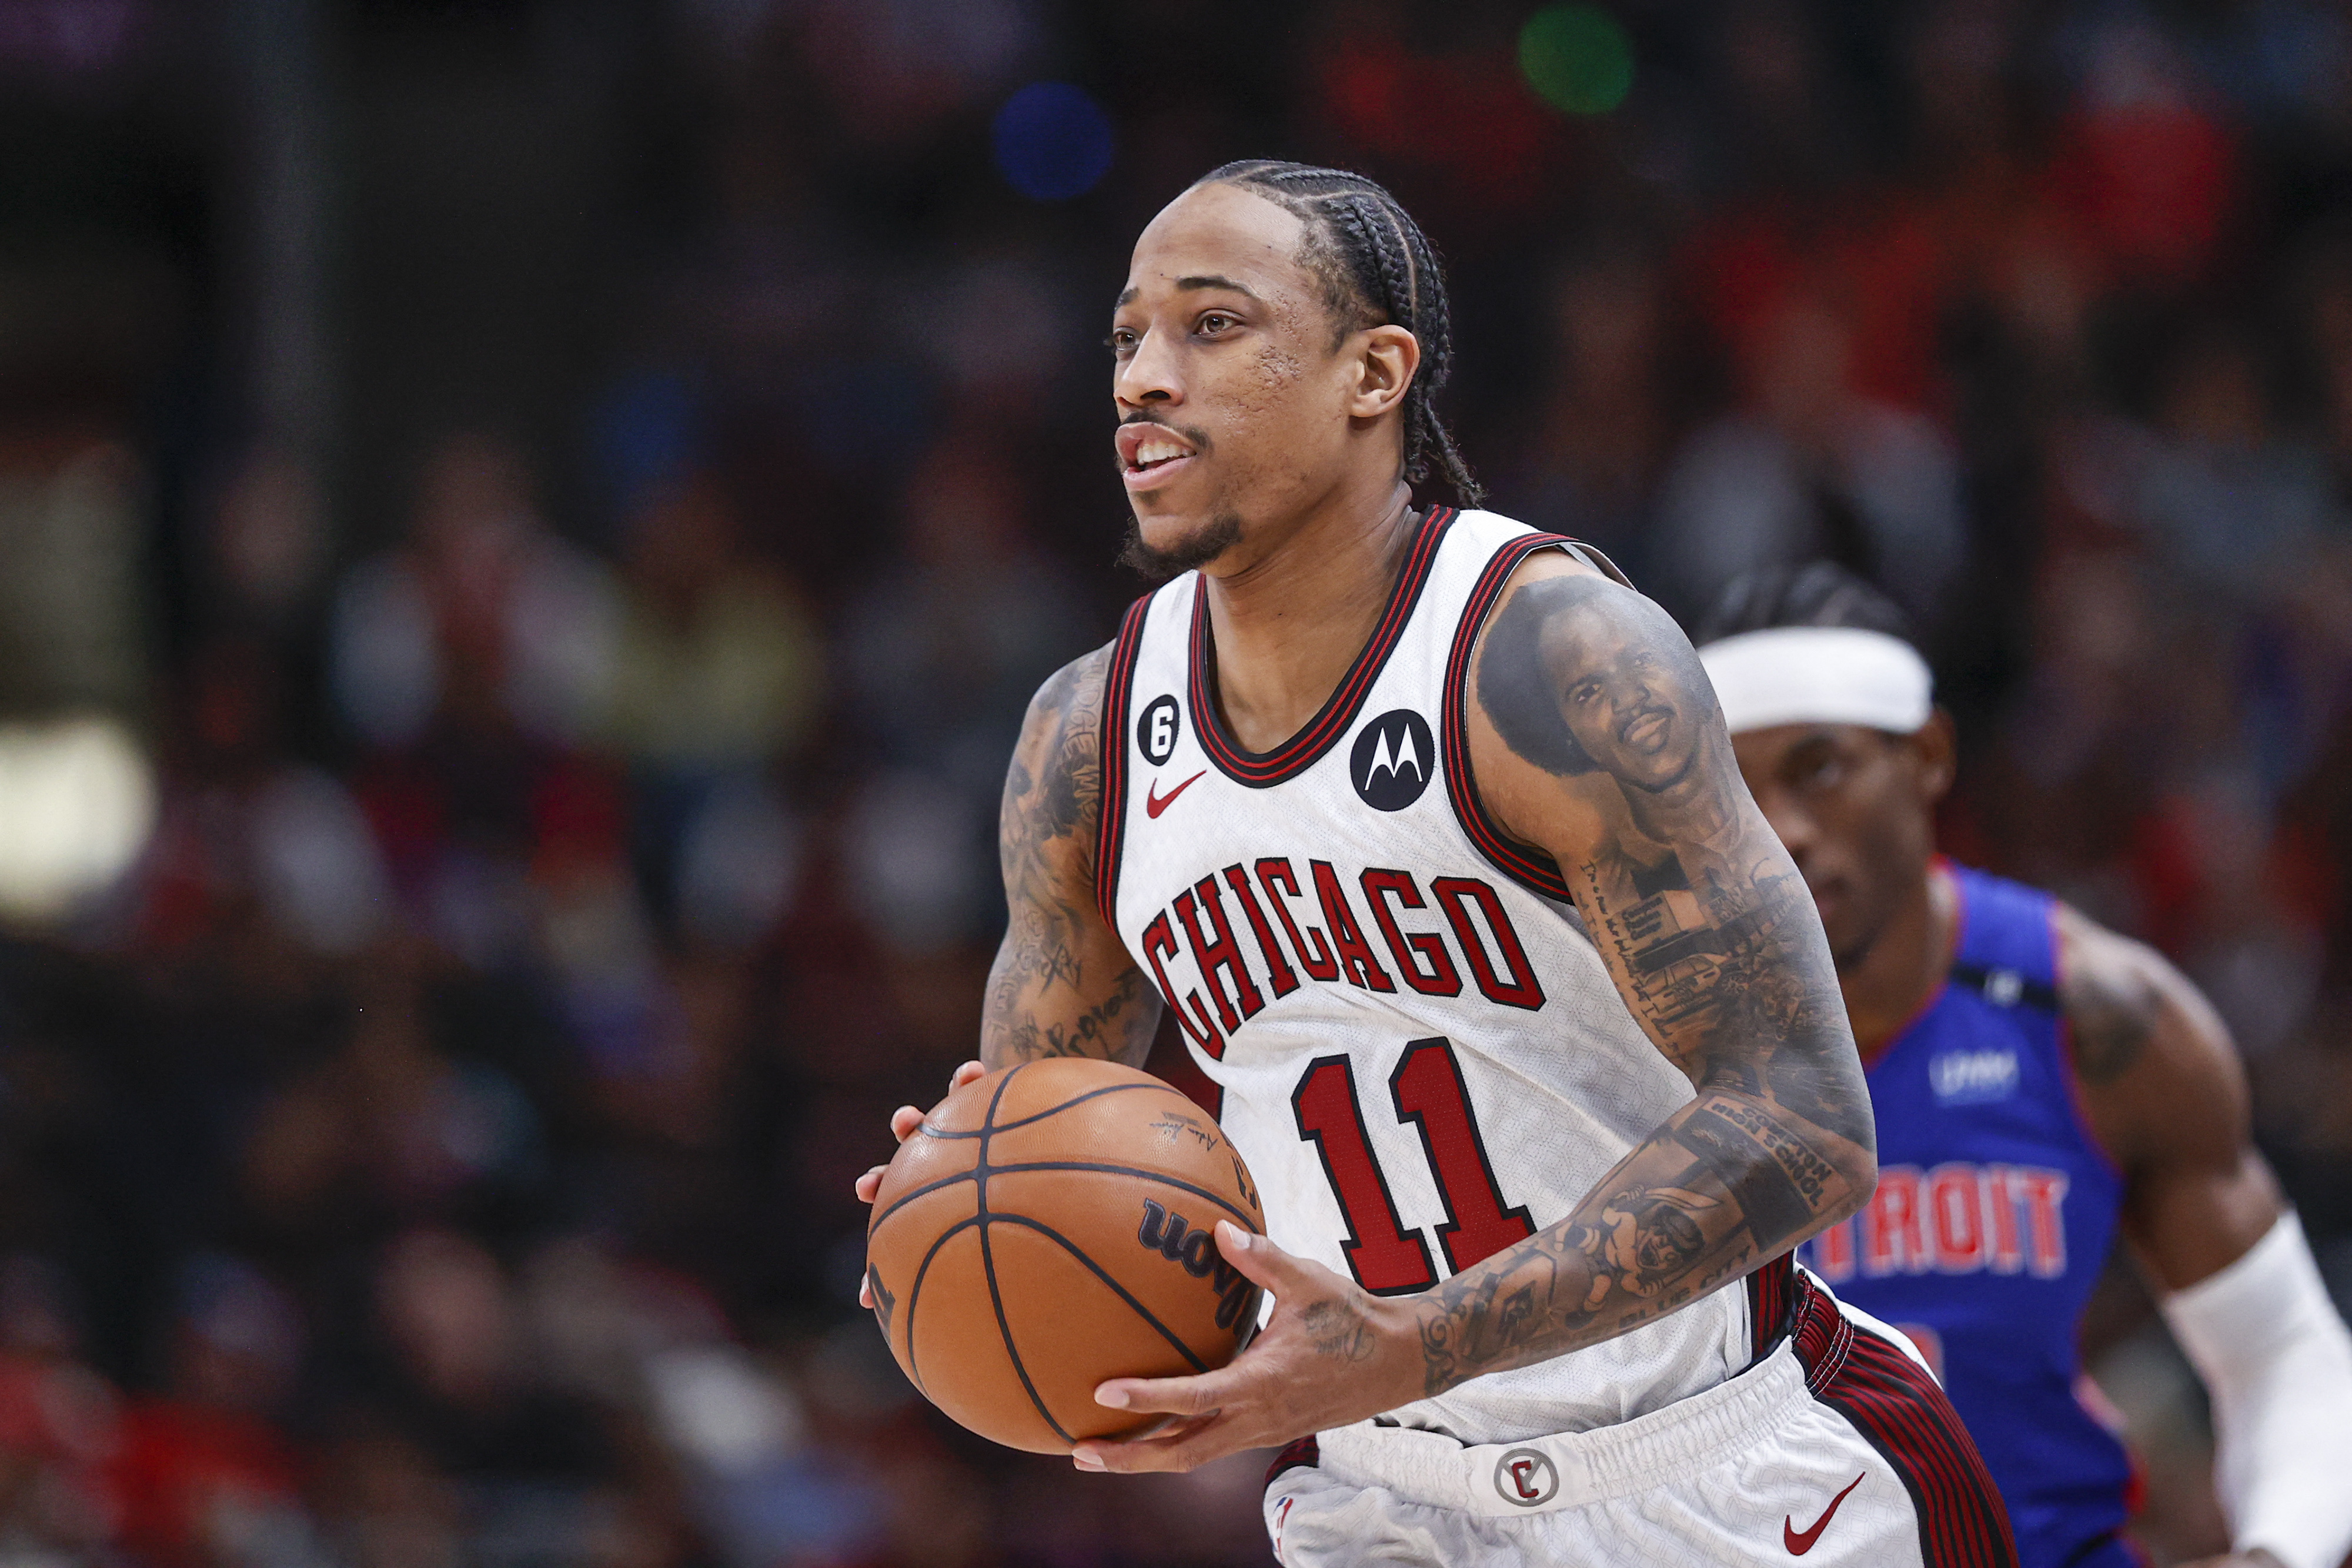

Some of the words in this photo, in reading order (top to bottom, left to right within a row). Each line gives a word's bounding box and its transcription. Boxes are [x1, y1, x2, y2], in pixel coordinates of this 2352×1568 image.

[1150, 705, 1174, 758] 6
[1142, 857, 1547, 1060] CHICAGO
[1291, 1036, 1538, 1297] 11
[1813, 1162, 2068, 1283] ROIT
[1512, 1460, 1539, 1498] C
